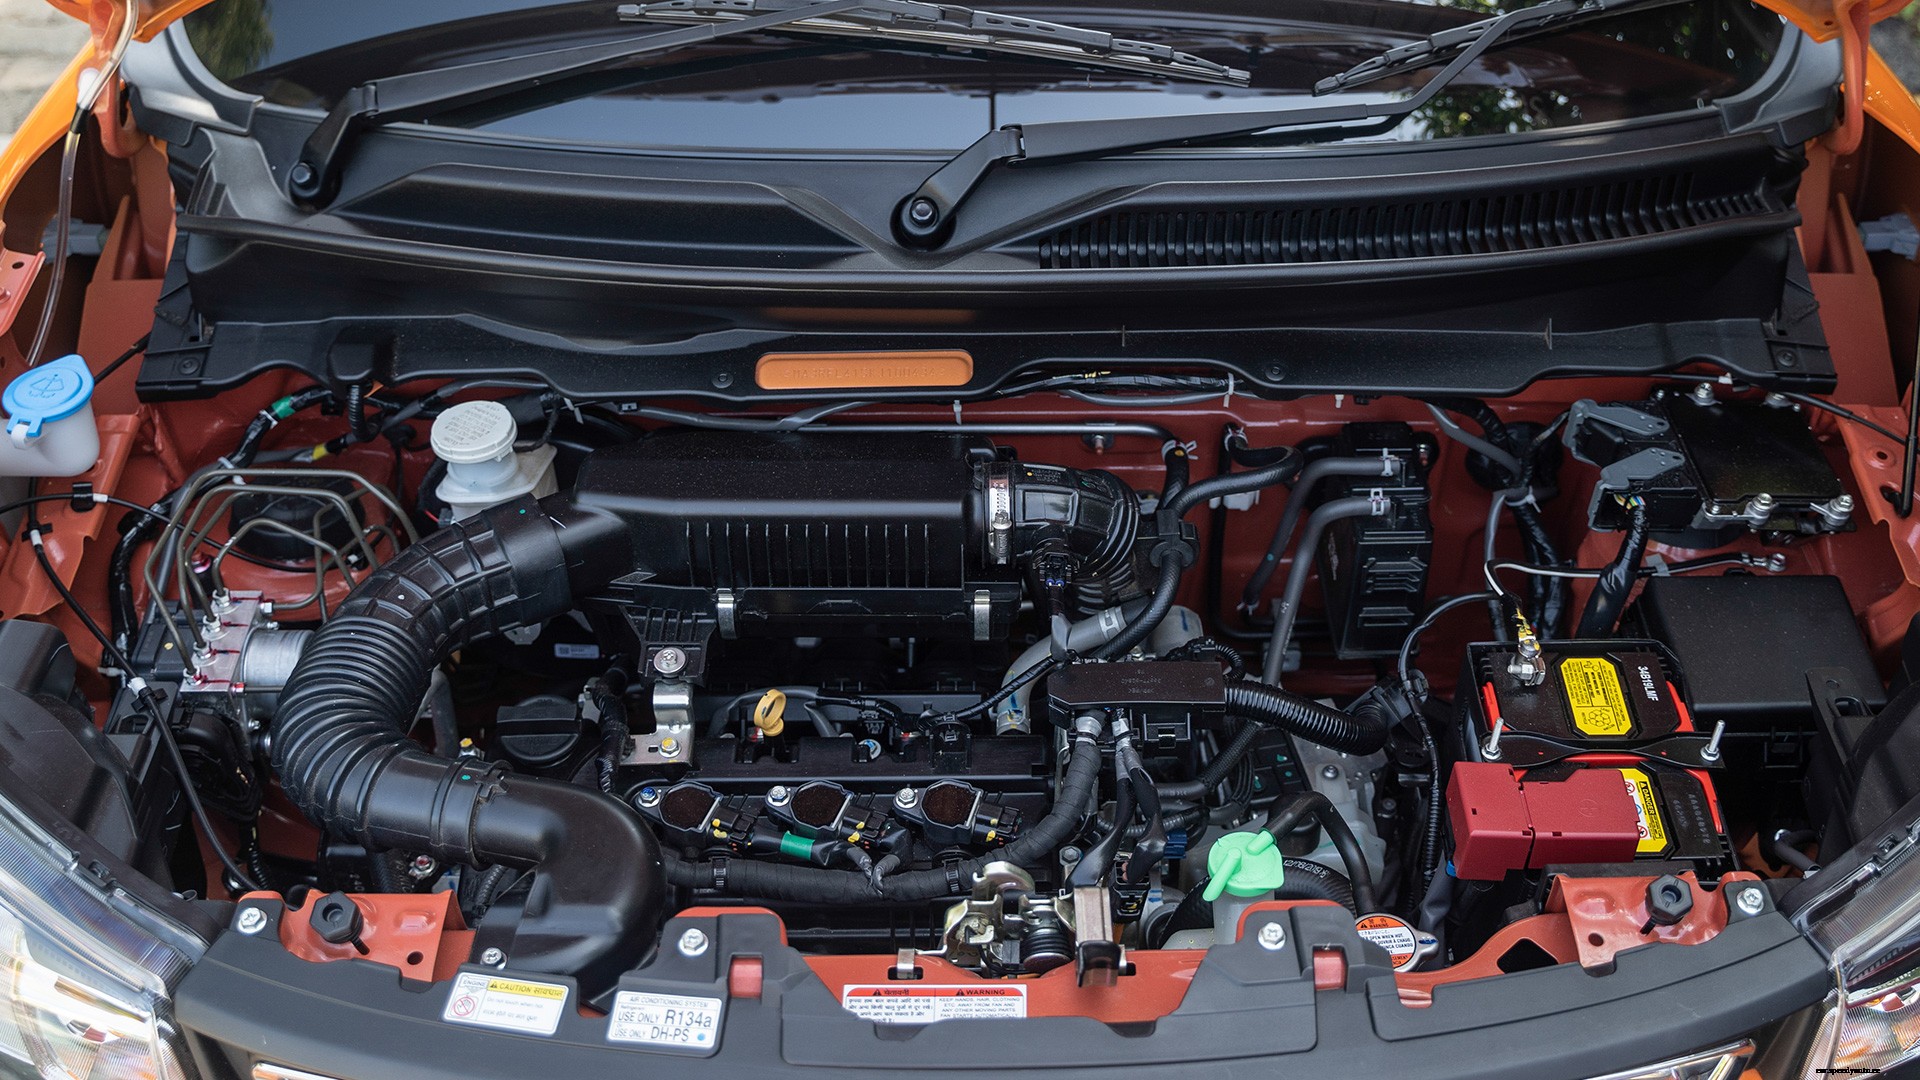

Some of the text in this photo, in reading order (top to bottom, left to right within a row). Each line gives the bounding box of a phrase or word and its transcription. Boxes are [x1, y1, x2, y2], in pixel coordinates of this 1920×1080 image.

[1643, 788, 1655, 816] DANGER
[500, 983, 531, 992] CAUTION
[641, 997, 682, 1006] CONDITIONING
[618, 1009, 712, 1028] USE ONLY R134a
[615, 1026, 690, 1042] USE ONLY DH-PS
